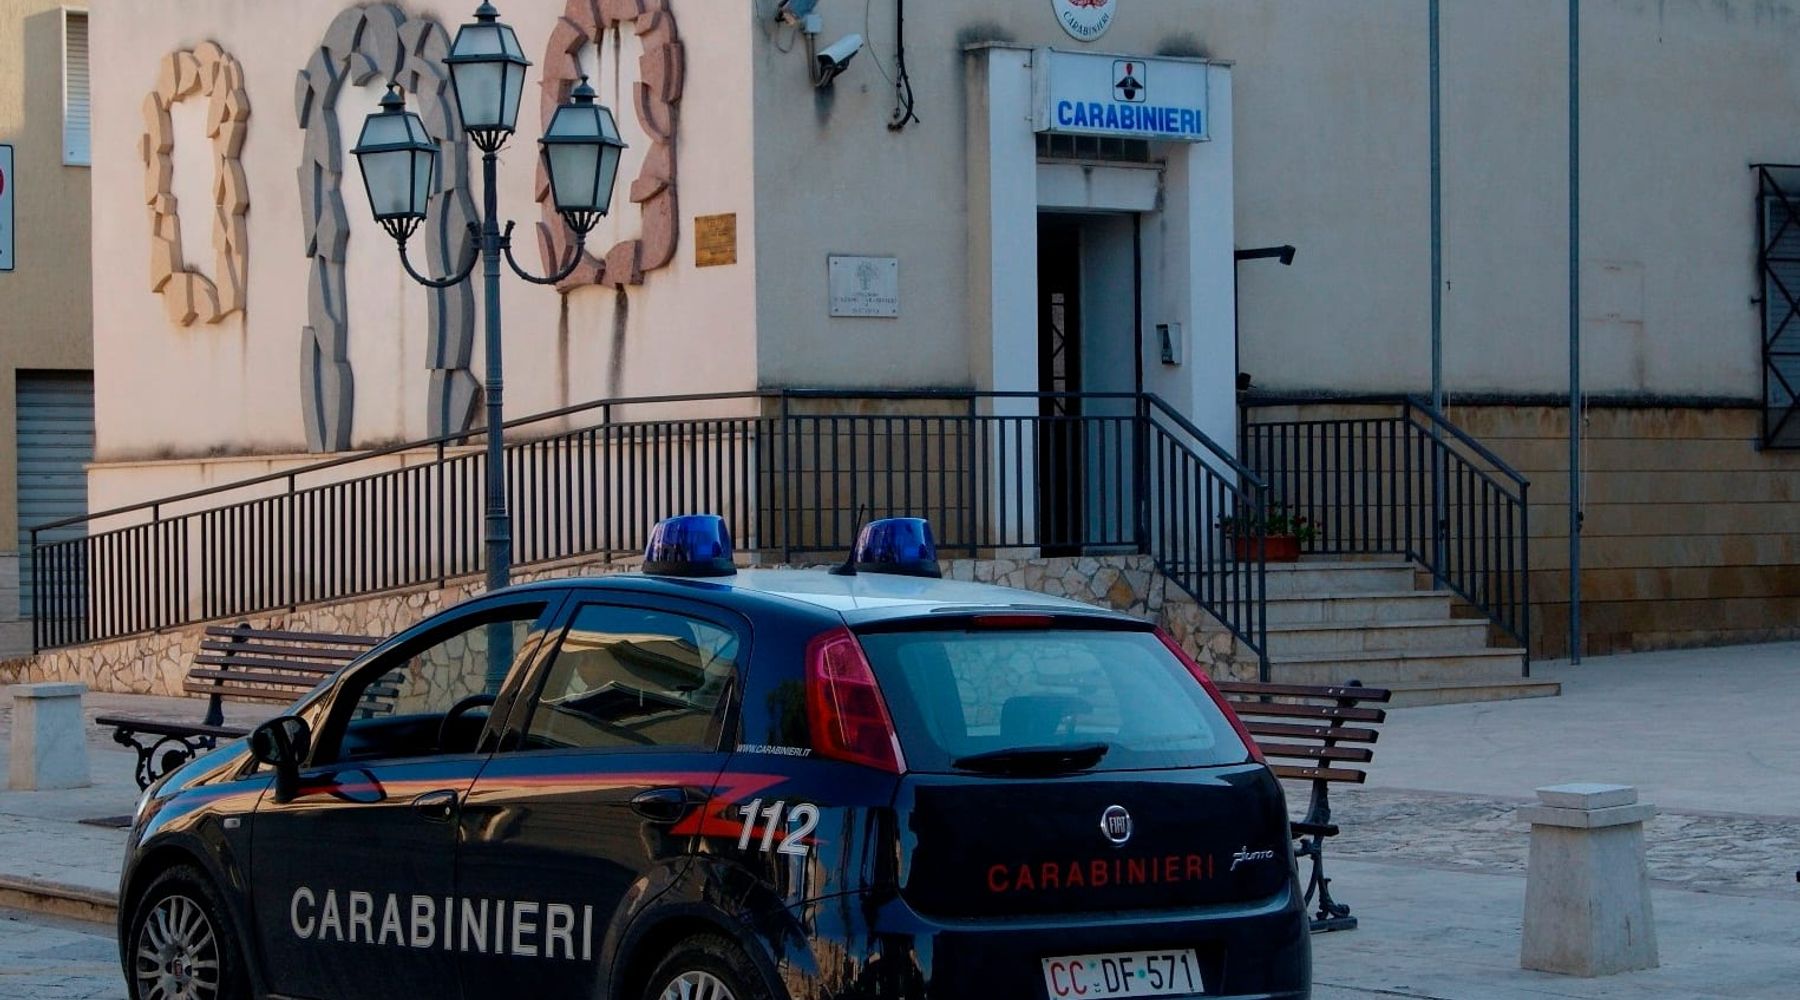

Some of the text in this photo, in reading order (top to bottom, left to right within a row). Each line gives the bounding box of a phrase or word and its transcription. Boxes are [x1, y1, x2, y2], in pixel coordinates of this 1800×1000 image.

[1063, 11, 1110, 36] CARABINIERI
[1058, 101, 1202, 134] CARABINIERI
[738, 798, 820, 856] 112
[1109, 816, 1125, 833] FIAT
[987, 854, 1215, 892] CARABINIERI
[290, 886, 593, 961] CARABINIERI
[1051, 954, 1194, 997] CC DF 571
